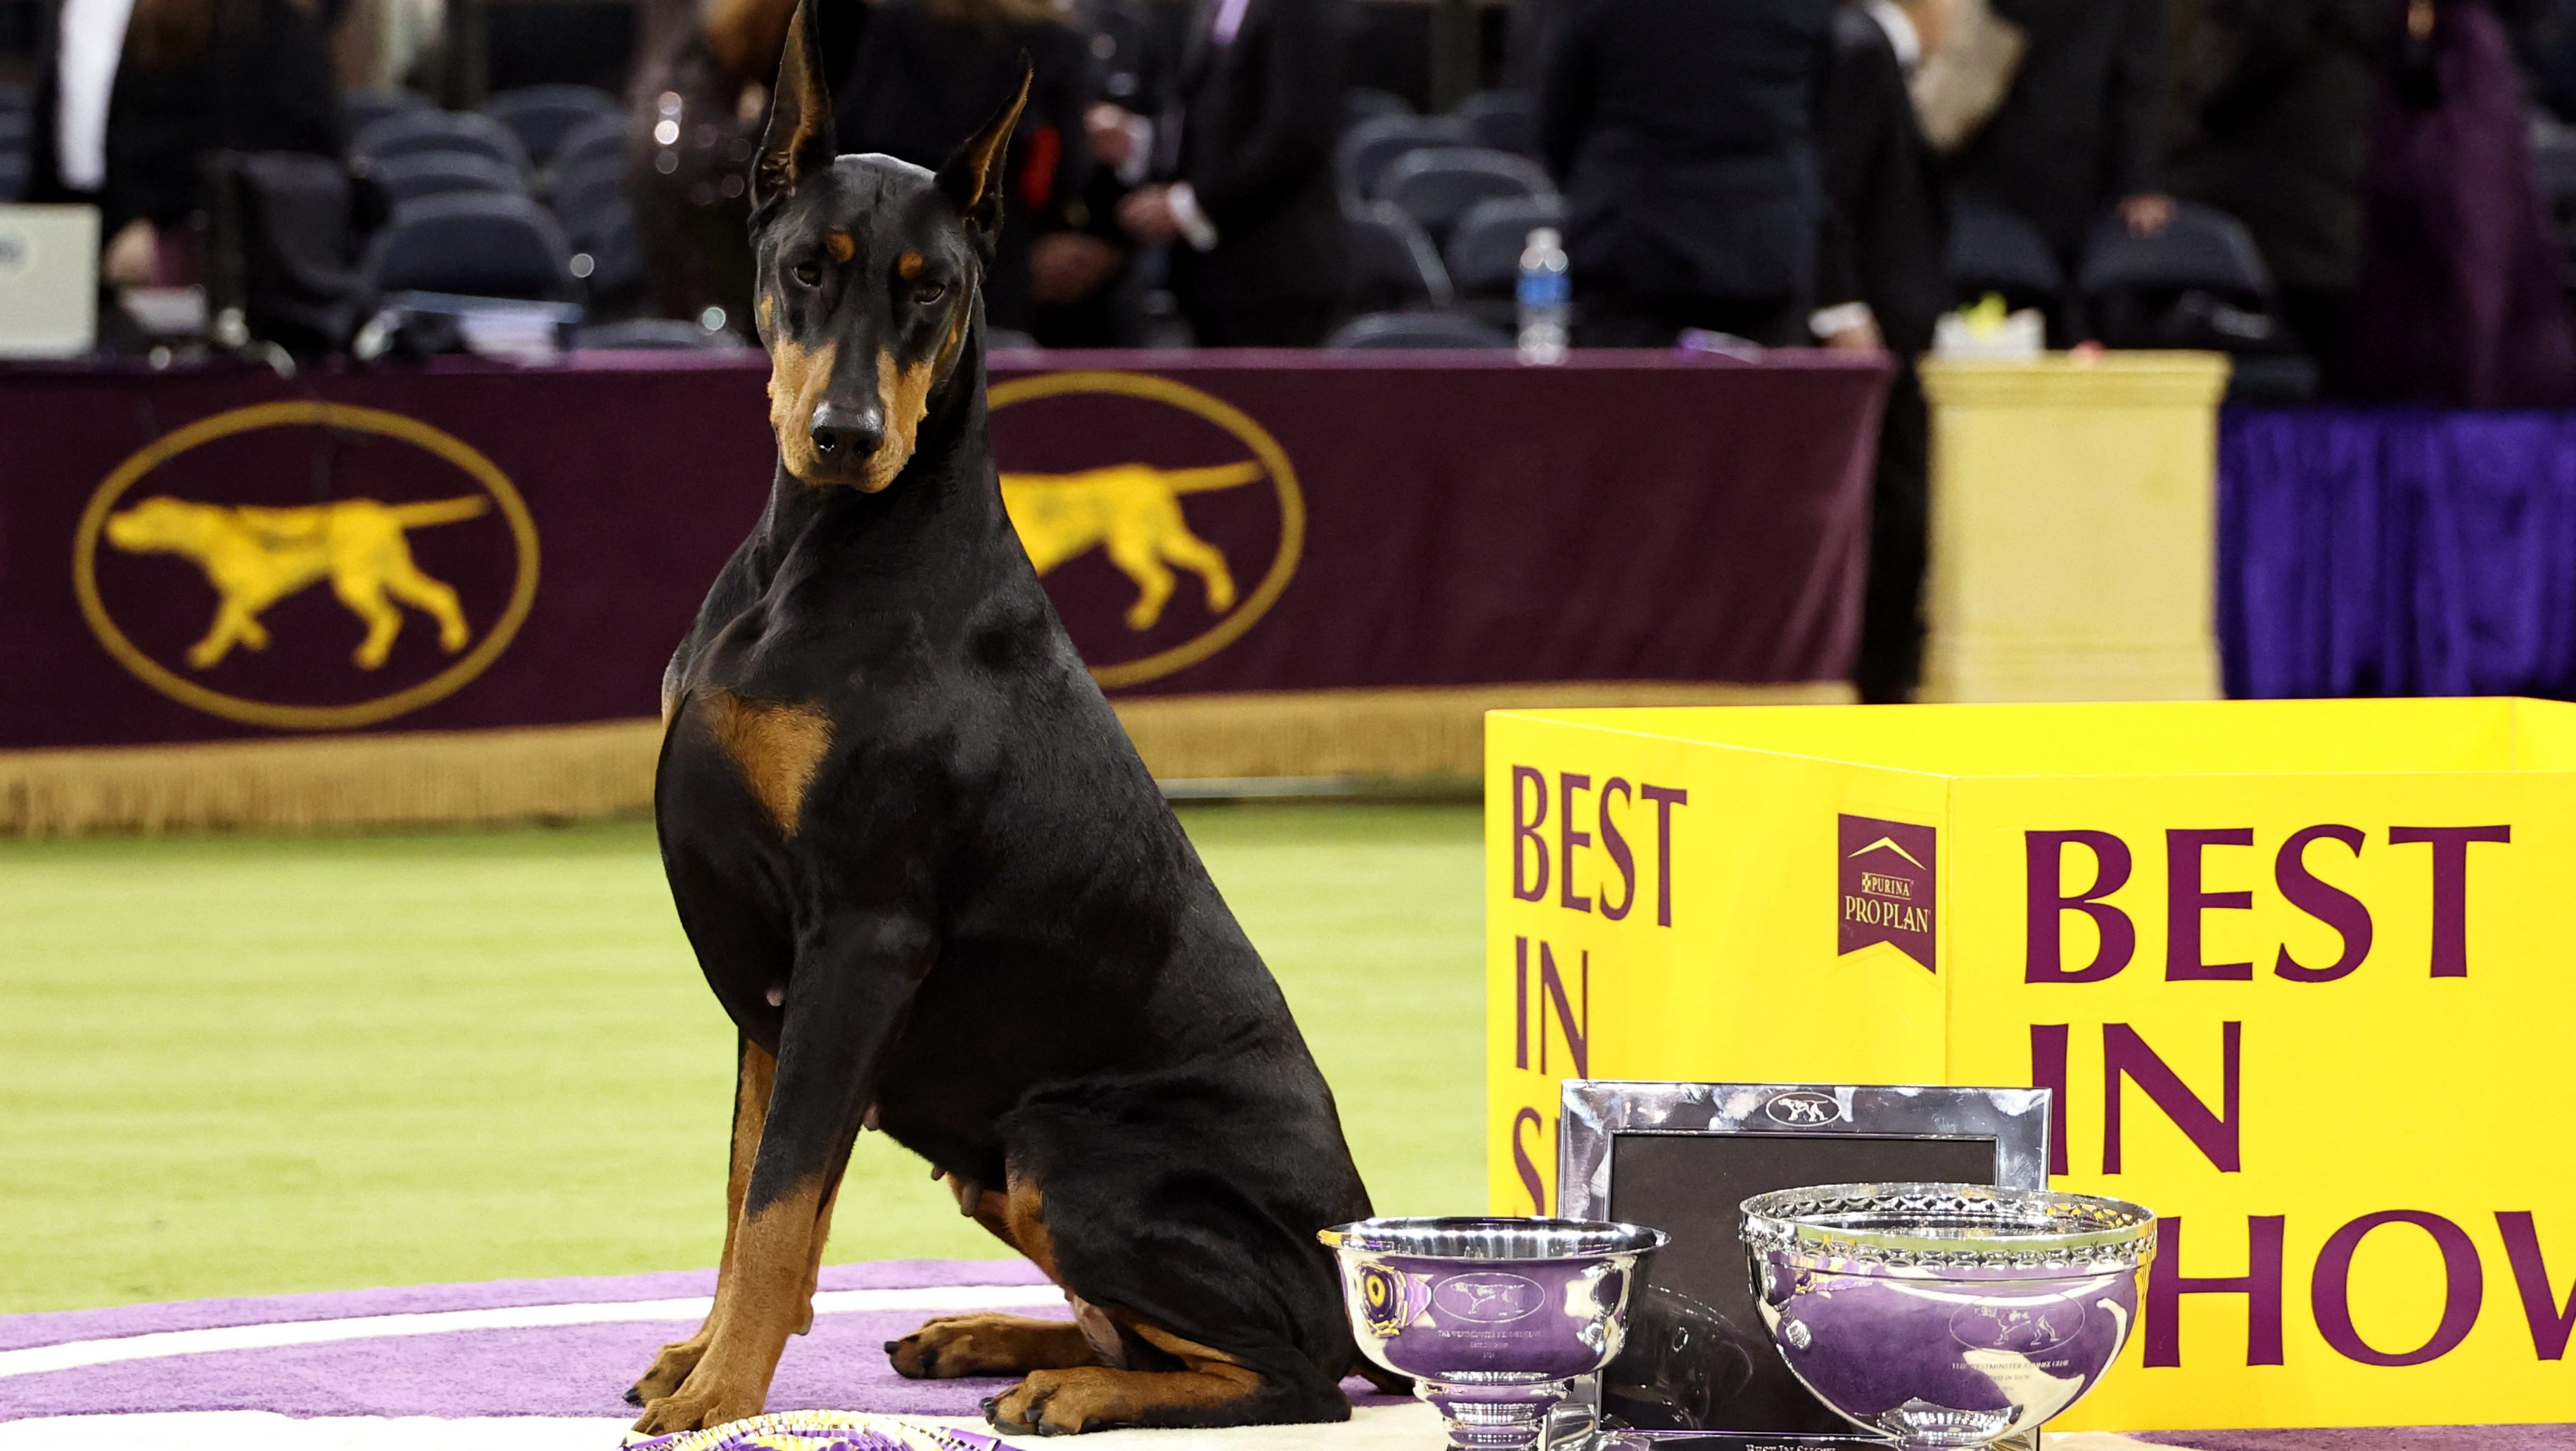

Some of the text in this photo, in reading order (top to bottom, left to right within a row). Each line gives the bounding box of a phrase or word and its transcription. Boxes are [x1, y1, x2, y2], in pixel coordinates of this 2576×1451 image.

[1512, 765, 1688, 928] BEST
[1845, 895, 1929, 933] PRO PLAN
[1872, 877, 1911, 897] PURINA
[2025, 824, 2511, 983] BEST
[1515, 935, 1588, 1080] IN
[2030, 1021, 2242, 1175] IN
